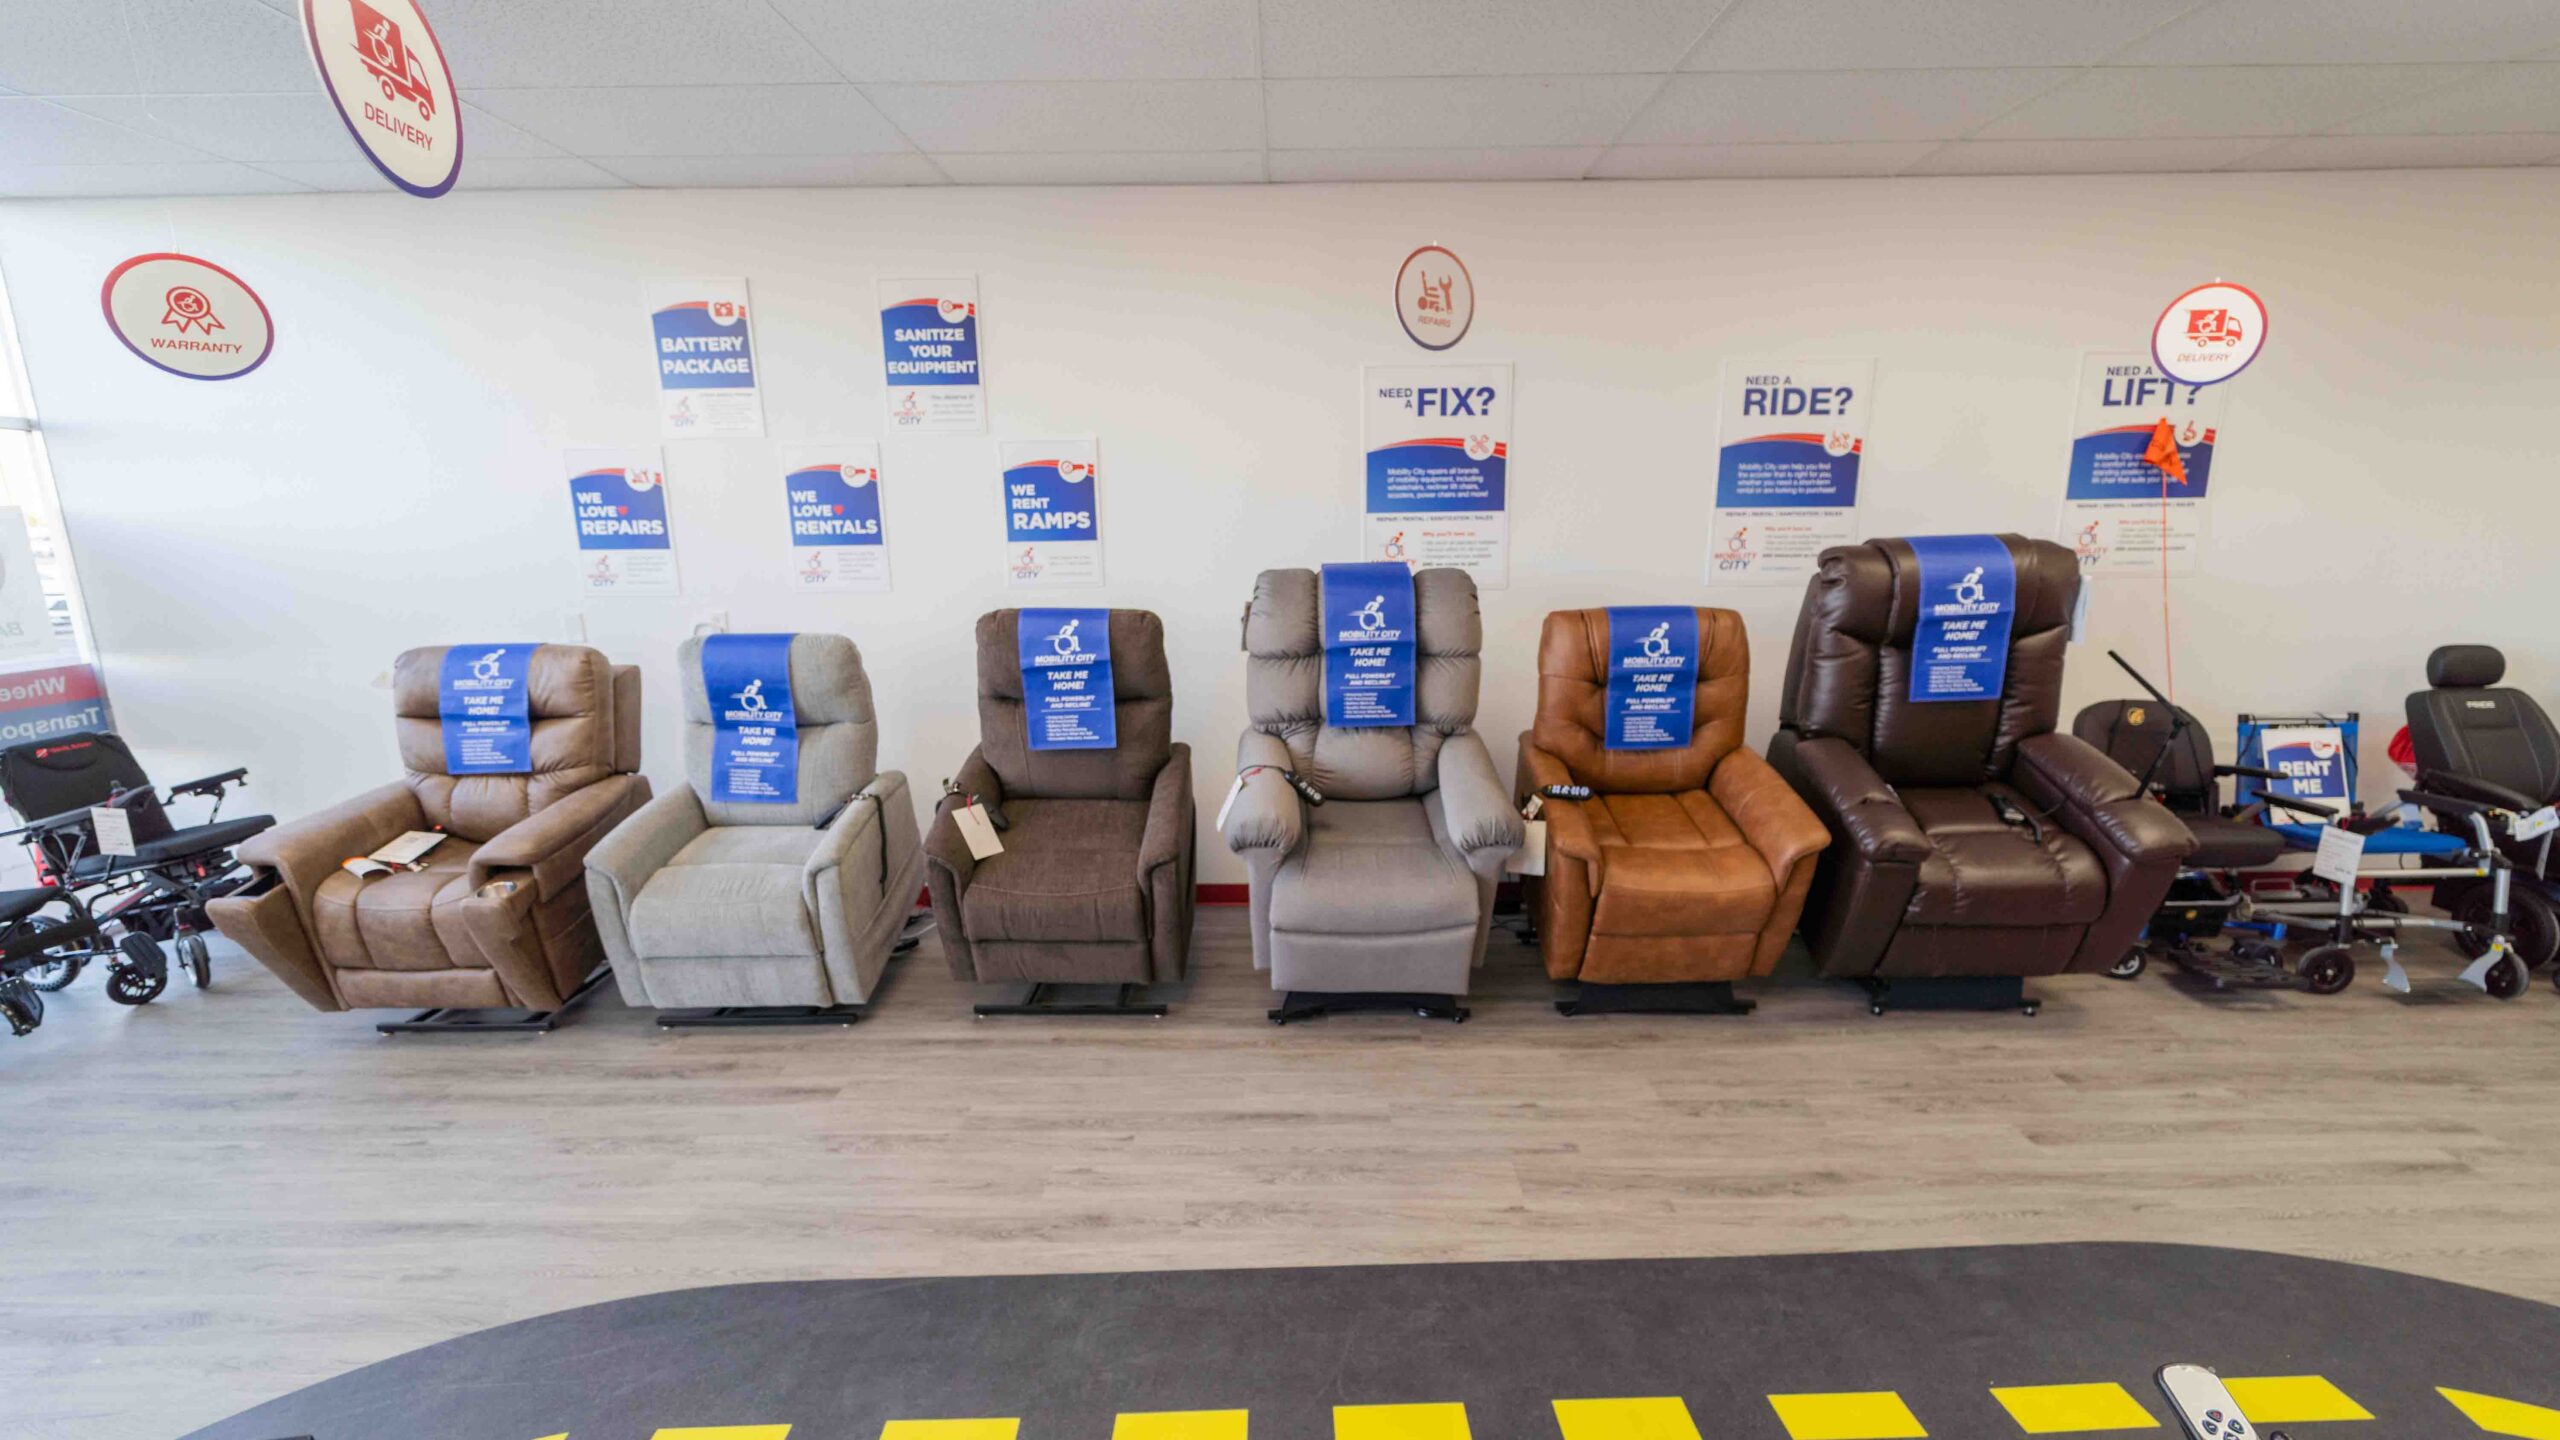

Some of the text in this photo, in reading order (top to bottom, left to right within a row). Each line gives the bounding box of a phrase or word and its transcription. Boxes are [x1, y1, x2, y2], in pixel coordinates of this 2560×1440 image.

[364, 101, 433, 151] DELIVERY
[1417, 315, 1451, 328] REPAIRS
[894, 328, 965, 341] SANITIZE
[151, 337, 242, 354] WARRANTY
[660, 336, 744, 353] BATTERY
[909, 344, 953, 357] YOUR
[2176, 352, 2232, 363] DELIVERY
[662, 358, 750, 375] PACKAGE
[887, 360, 977, 375] EQUIPMENT
[2106, 366, 2153, 376] NEED A
[1745, 375, 1792, 385] NEED A
[1379, 387, 1413, 398] NEED
[1404, 400, 1413, 409] A
[1417, 386, 1496, 417] FIX?
[1743, 386, 1853, 416] RIDE?
[1010, 484, 1036, 497] WE
[576, 491, 603, 504] WE
[791, 490, 817, 503] WE
[1012, 497, 1050, 510] RENT
[579, 505, 618, 518] LOVE
[792, 504, 833, 517] LOVE
[1013, 511, 1092, 530] RAMPS
[580, 520, 665, 535] REPAIRS
[795, 519, 878, 535] RENTALS
[1719, 560, 1751, 571] CITY
[1934, 603, 2001, 613] MOBILITY CITY
[1942, 621, 1987, 630] TAKE ME
[1339, 630, 1401, 639] MOBILITY CITY
[1944, 631, 1979, 641] HOME!
[1350, 647, 1391, 656] TAKE ME
[1035, 653, 1096, 663] MOBILITY CITY
[1354, 658, 1387, 667] HOME!
[1623, 656, 1685, 665] MOBILITY CITY
[1047, 670, 1089, 680] TAKE ME
[1632, 674, 1675, 683] TAKE ME
[1053, 681, 1085, 691] HOME!
[1635, 684, 1668, 693] HOME!
[463, 696, 504, 705] TAKE ME
[468, 706, 500, 715] HOME!
[725, 711, 783, 720] MOBILITY CITY
[738, 726, 777, 736] TAKE ME
[741, 736, 774, 746] HOME!
[2279, 760, 2332, 777] RENT
[2293, 778, 2323, 795] ME
